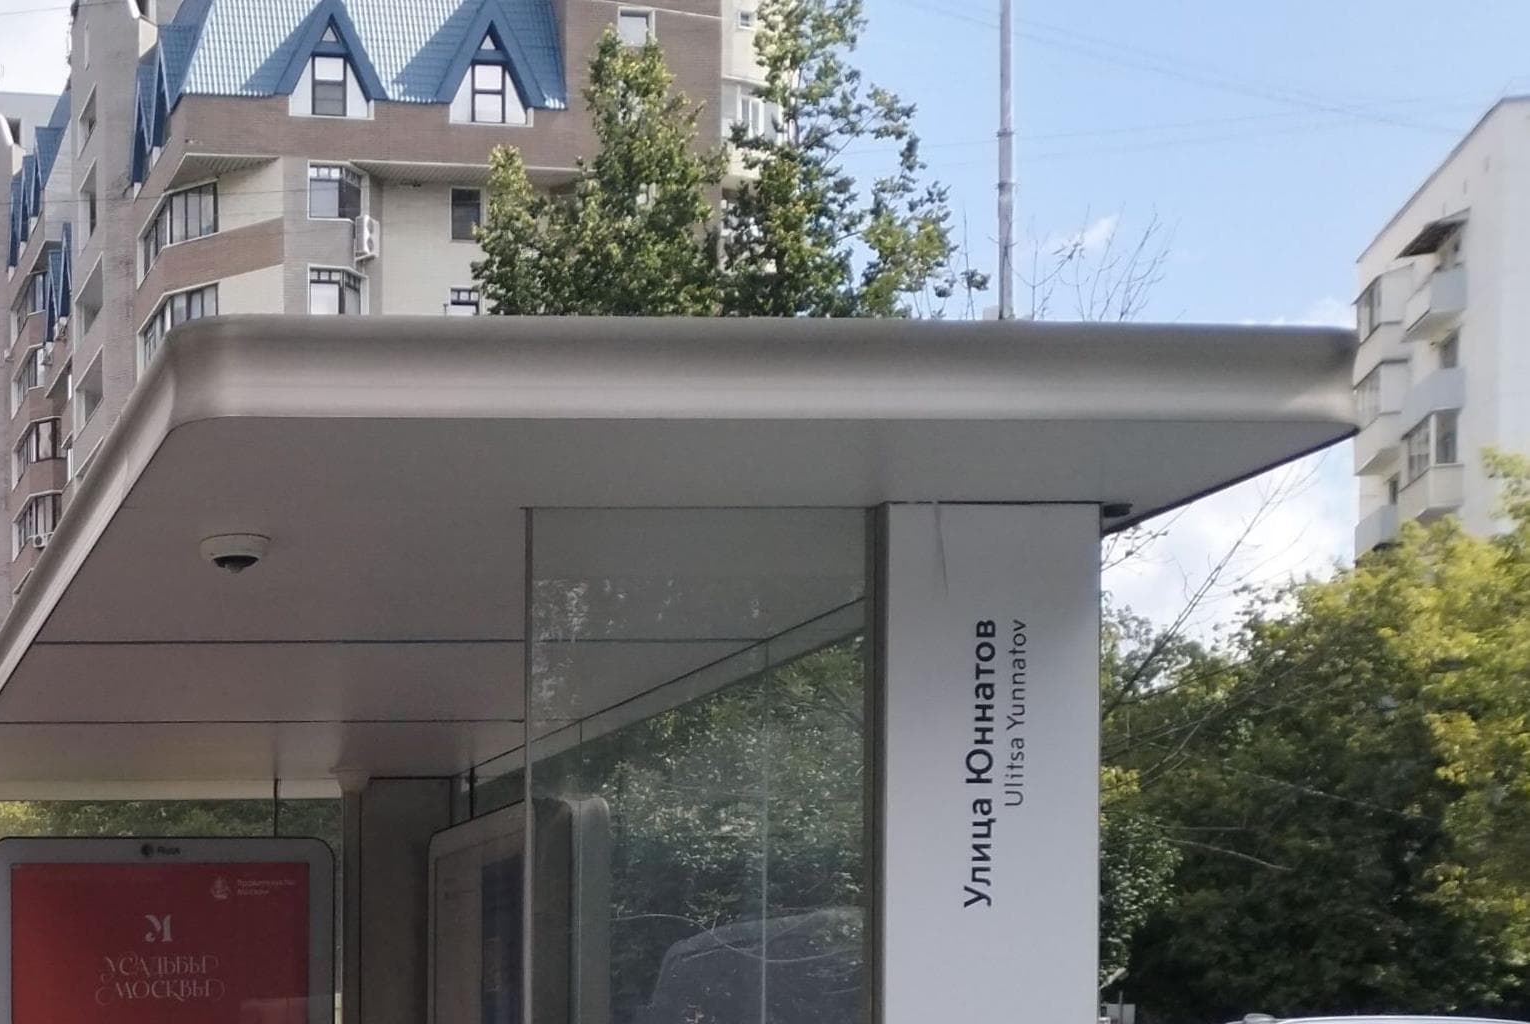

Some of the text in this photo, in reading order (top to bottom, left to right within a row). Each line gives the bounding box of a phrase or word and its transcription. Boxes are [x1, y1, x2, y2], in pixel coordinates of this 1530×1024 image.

[963, 618, 997, 908] Улица Юннатов
[1004, 619, 1027, 807] Ulitsa Yunnatov
